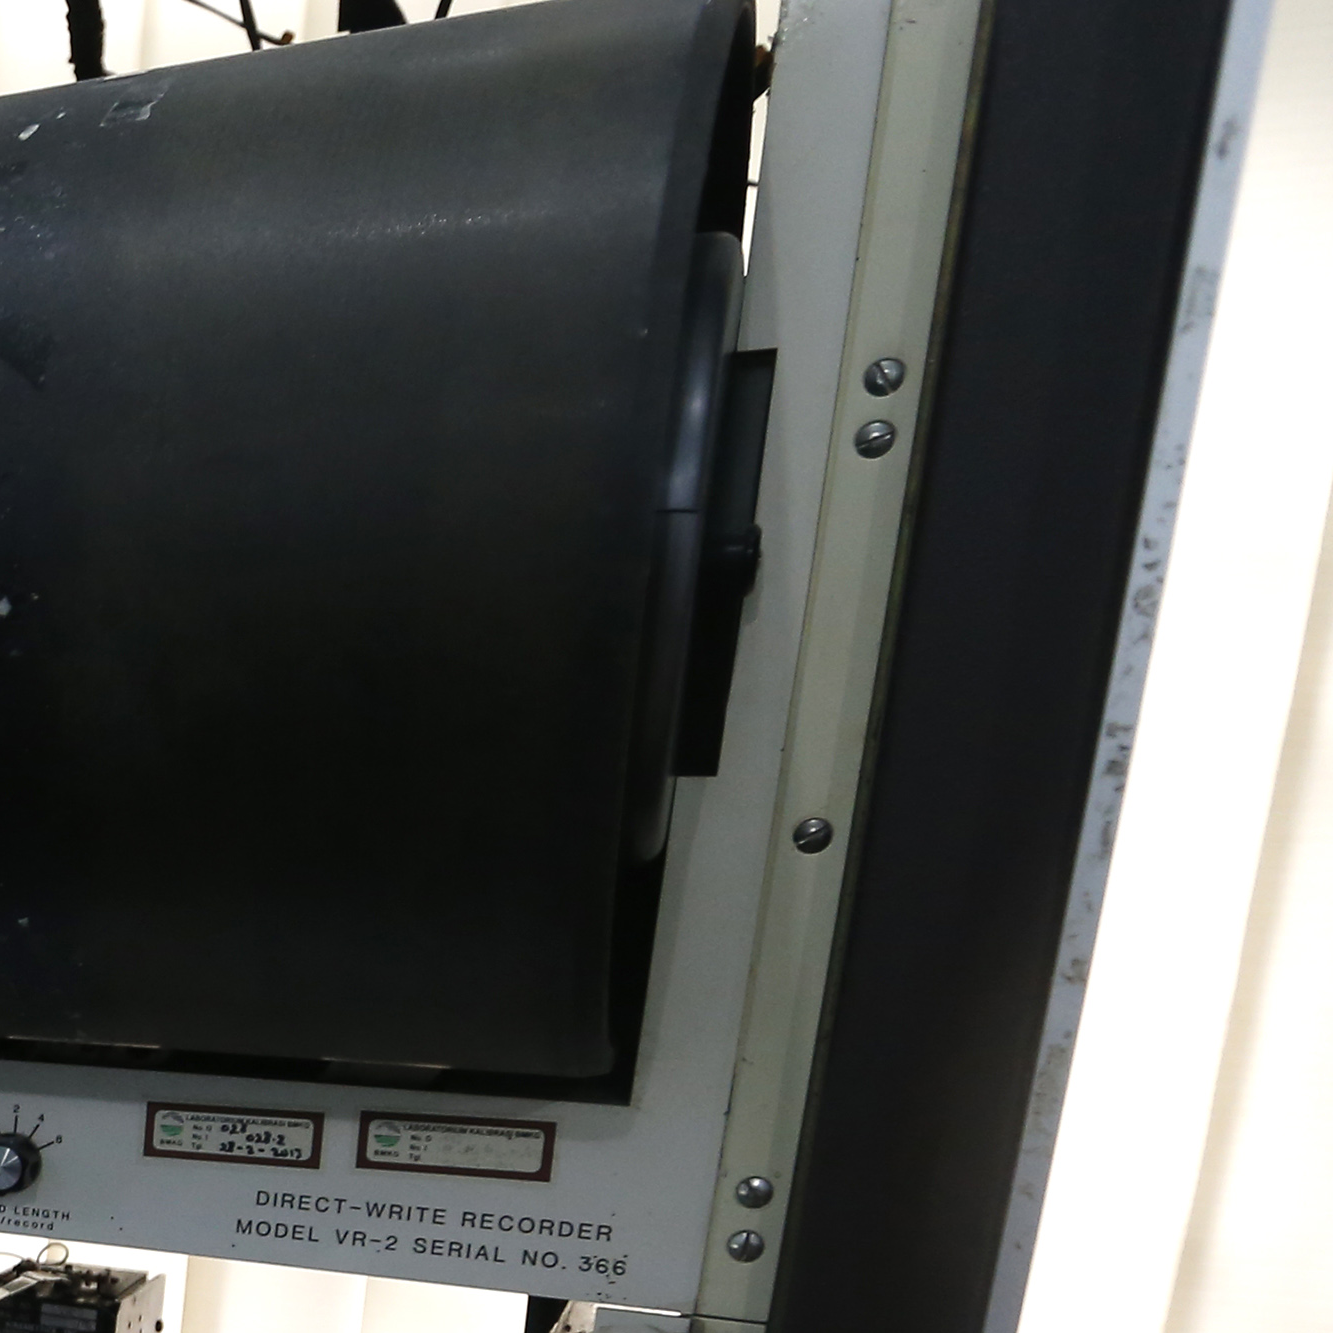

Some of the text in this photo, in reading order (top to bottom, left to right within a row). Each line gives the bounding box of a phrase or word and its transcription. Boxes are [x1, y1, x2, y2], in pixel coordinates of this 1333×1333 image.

[13, 1104, 21, 1114] 2
[37, 1113, 45, 1123] 4
[13, 1206, 71, 1221] LENGTH
[255, 1189, 614, 1242] DIRECT-WRITE RECORDER
[235, 1218, 628, 1277] MODEL VR-2 SERIAL NO. 366
